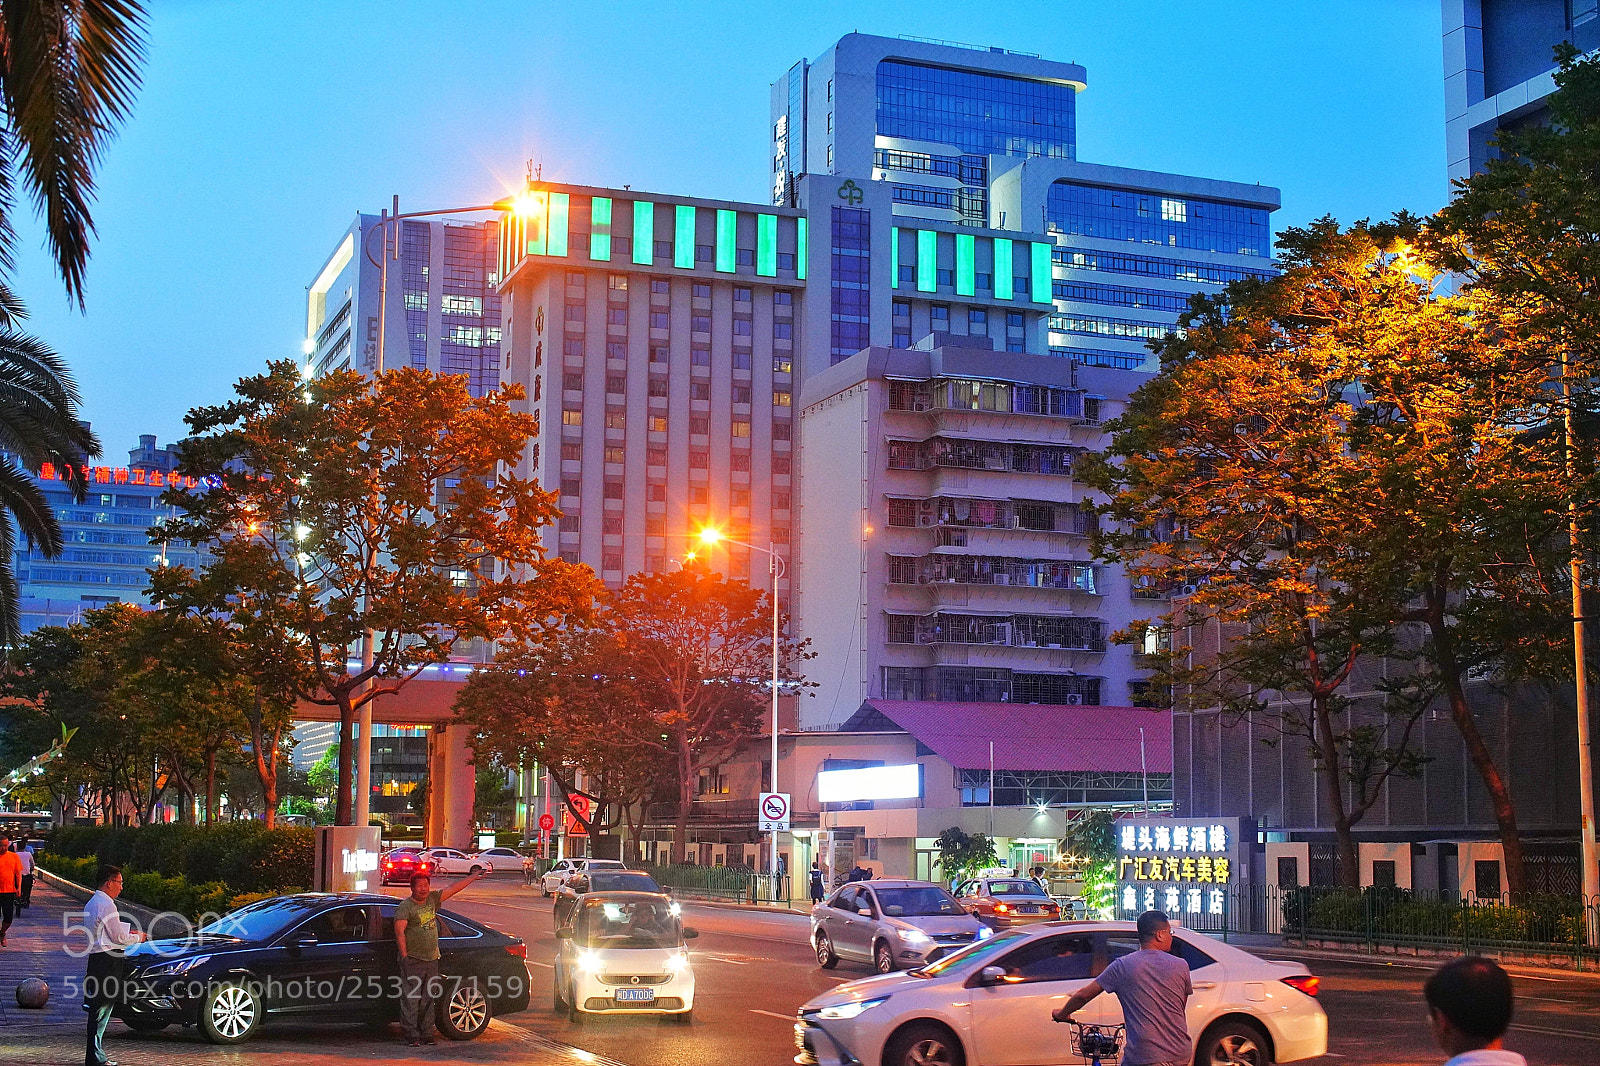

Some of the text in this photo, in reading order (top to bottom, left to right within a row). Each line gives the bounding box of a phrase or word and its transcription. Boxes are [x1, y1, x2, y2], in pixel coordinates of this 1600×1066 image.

[1119, 855, 1230, 884] 广汇友汽车美容
